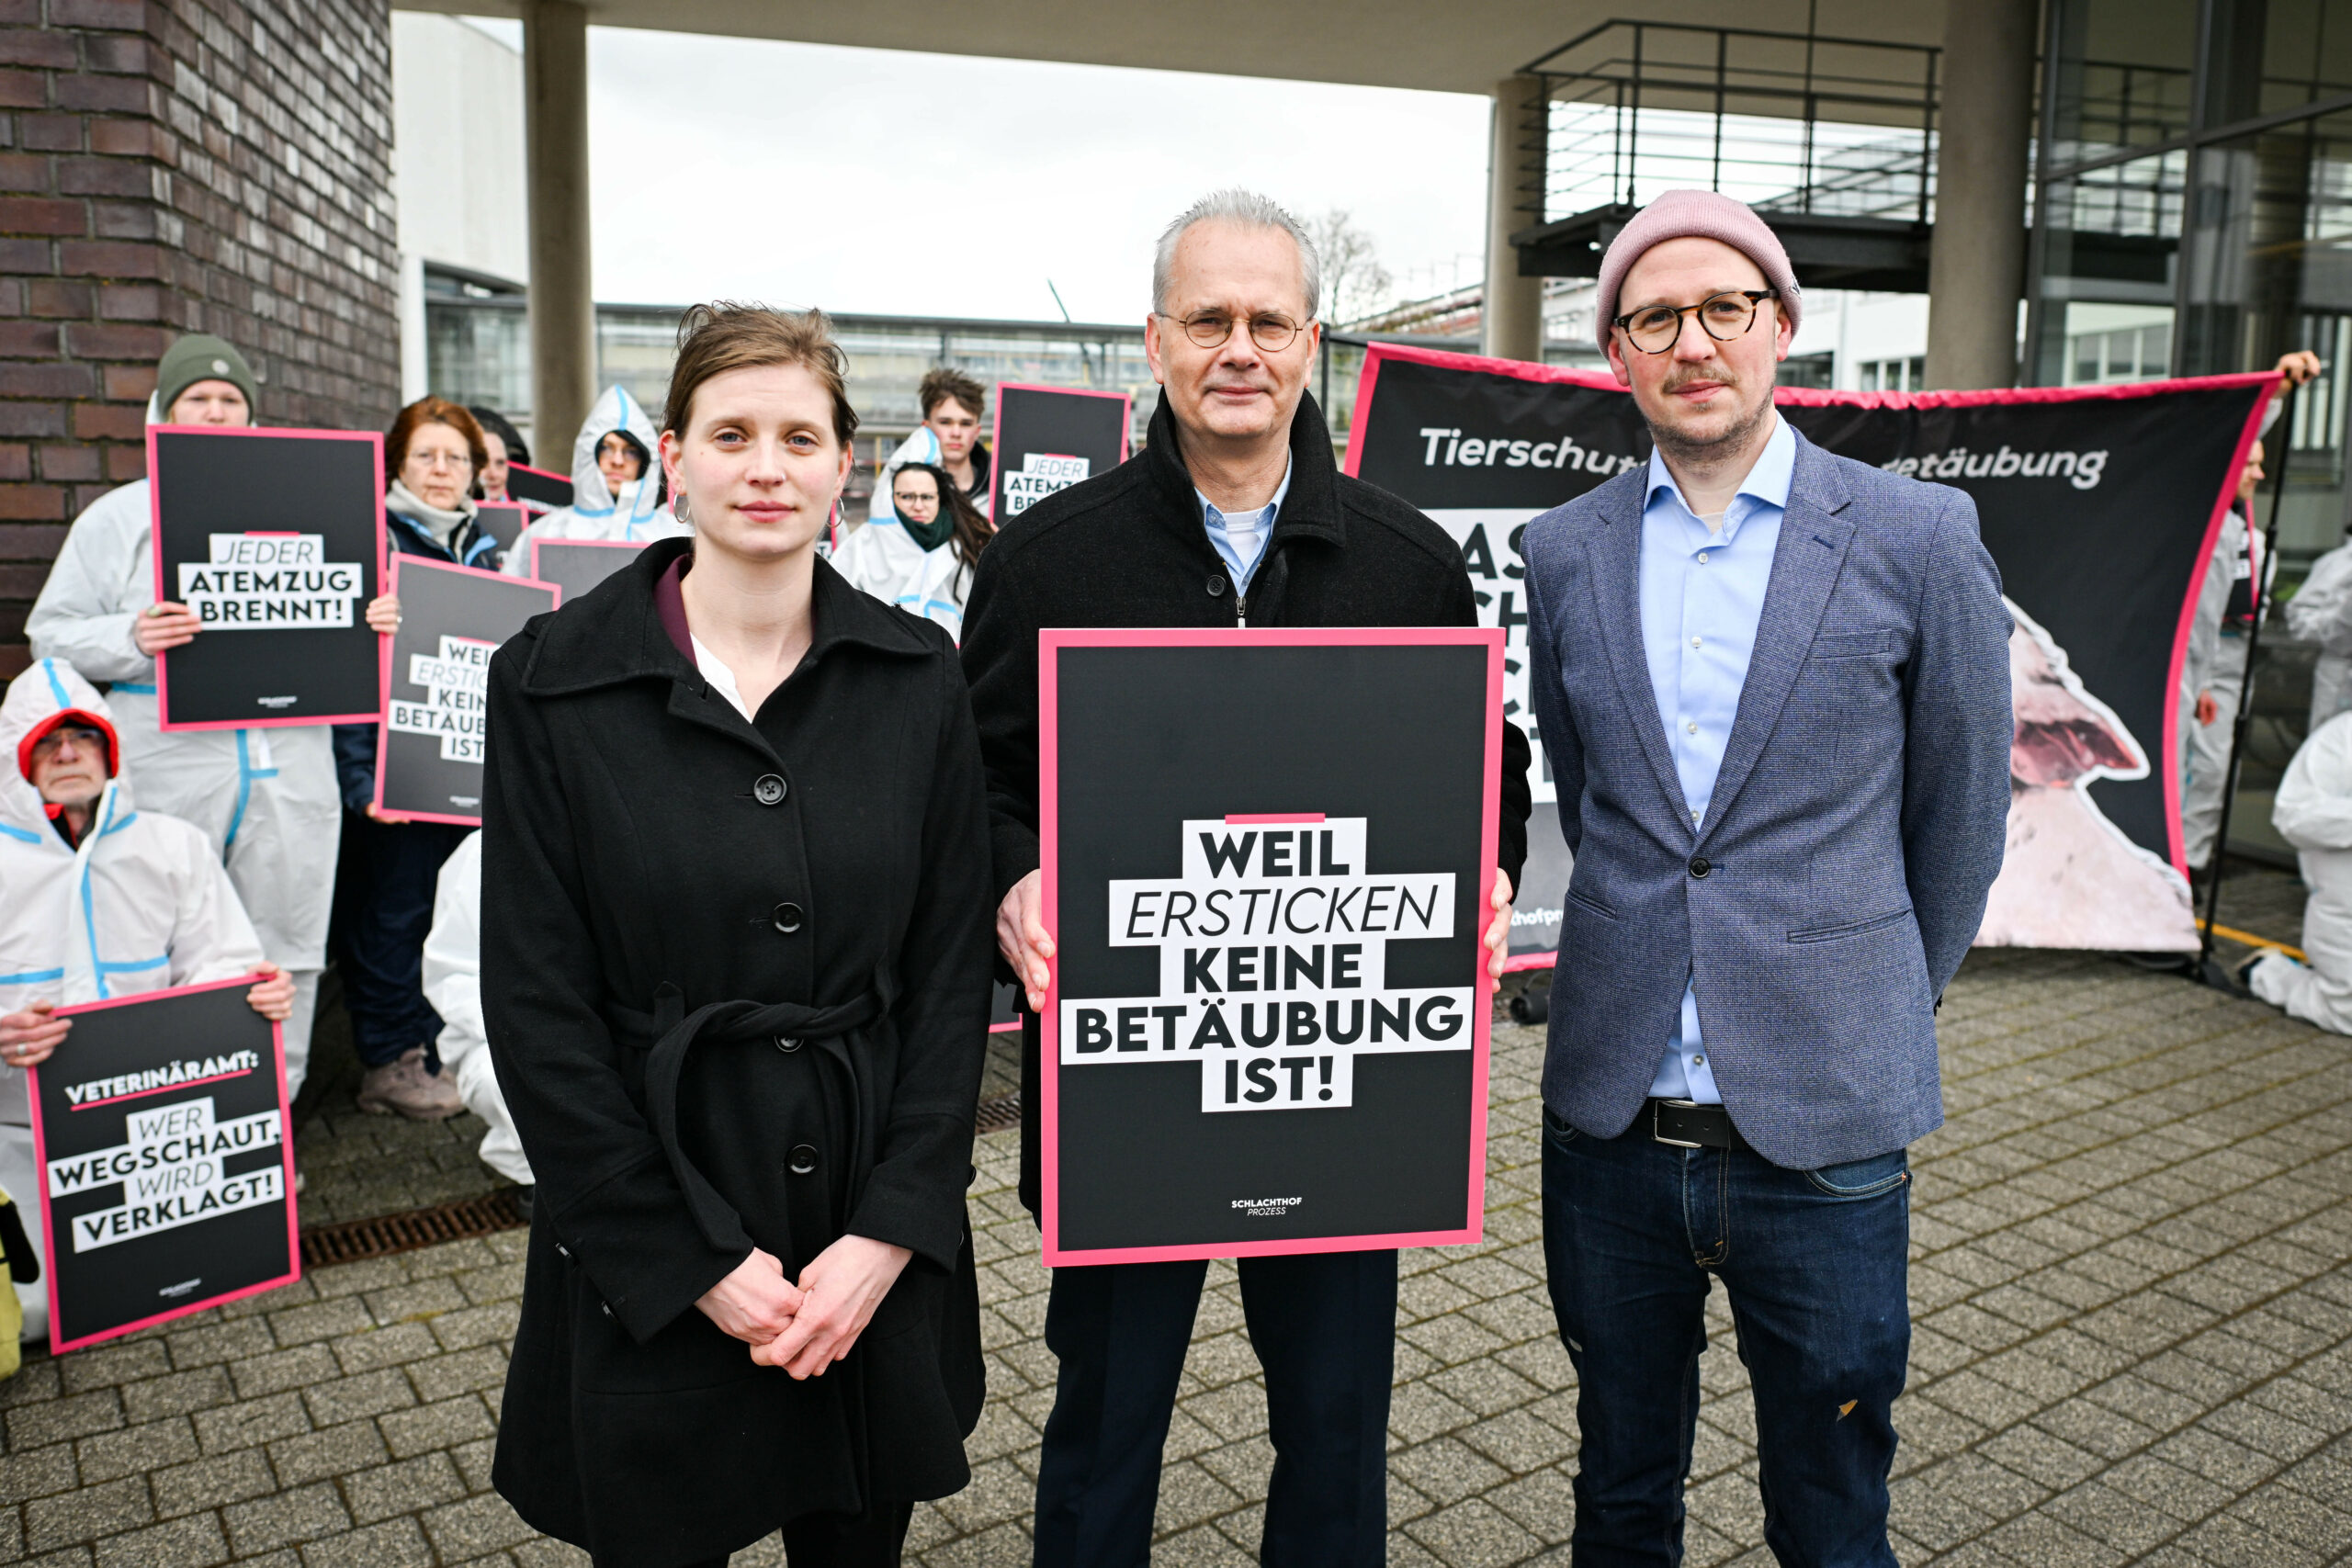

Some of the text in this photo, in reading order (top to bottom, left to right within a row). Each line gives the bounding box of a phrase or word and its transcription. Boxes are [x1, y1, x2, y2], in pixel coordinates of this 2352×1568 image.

[1419, 428, 1648, 475] Tierschut
[218, 541, 313, 564] JEDER
[189, 570, 353, 592] ATEMZUG
[200, 599, 343, 622] BRENNT!
[1199, 830, 1350, 878] WEIL
[1126, 885, 1438, 939] ERSTICKEN
[1183, 942, 1363, 994] KEINE
[1075, 995, 1464, 1054] BETÄUBUNG
[64, 1050, 259, 1105] VETERINÄRAMT:
[1225, 1055, 1334, 1104] IST!
[138, 1106, 203, 1140] WER
[54, 1119, 282, 1189] WEGSCHAUT,
[137, 1161, 214, 1200] WIRD
[1231, 1197, 1302, 1208] SCHLACHTHOF
[83, 1174, 273, 1241] VERKLAGT!
[1247, 1206, 1286, 1216] PROZESS
